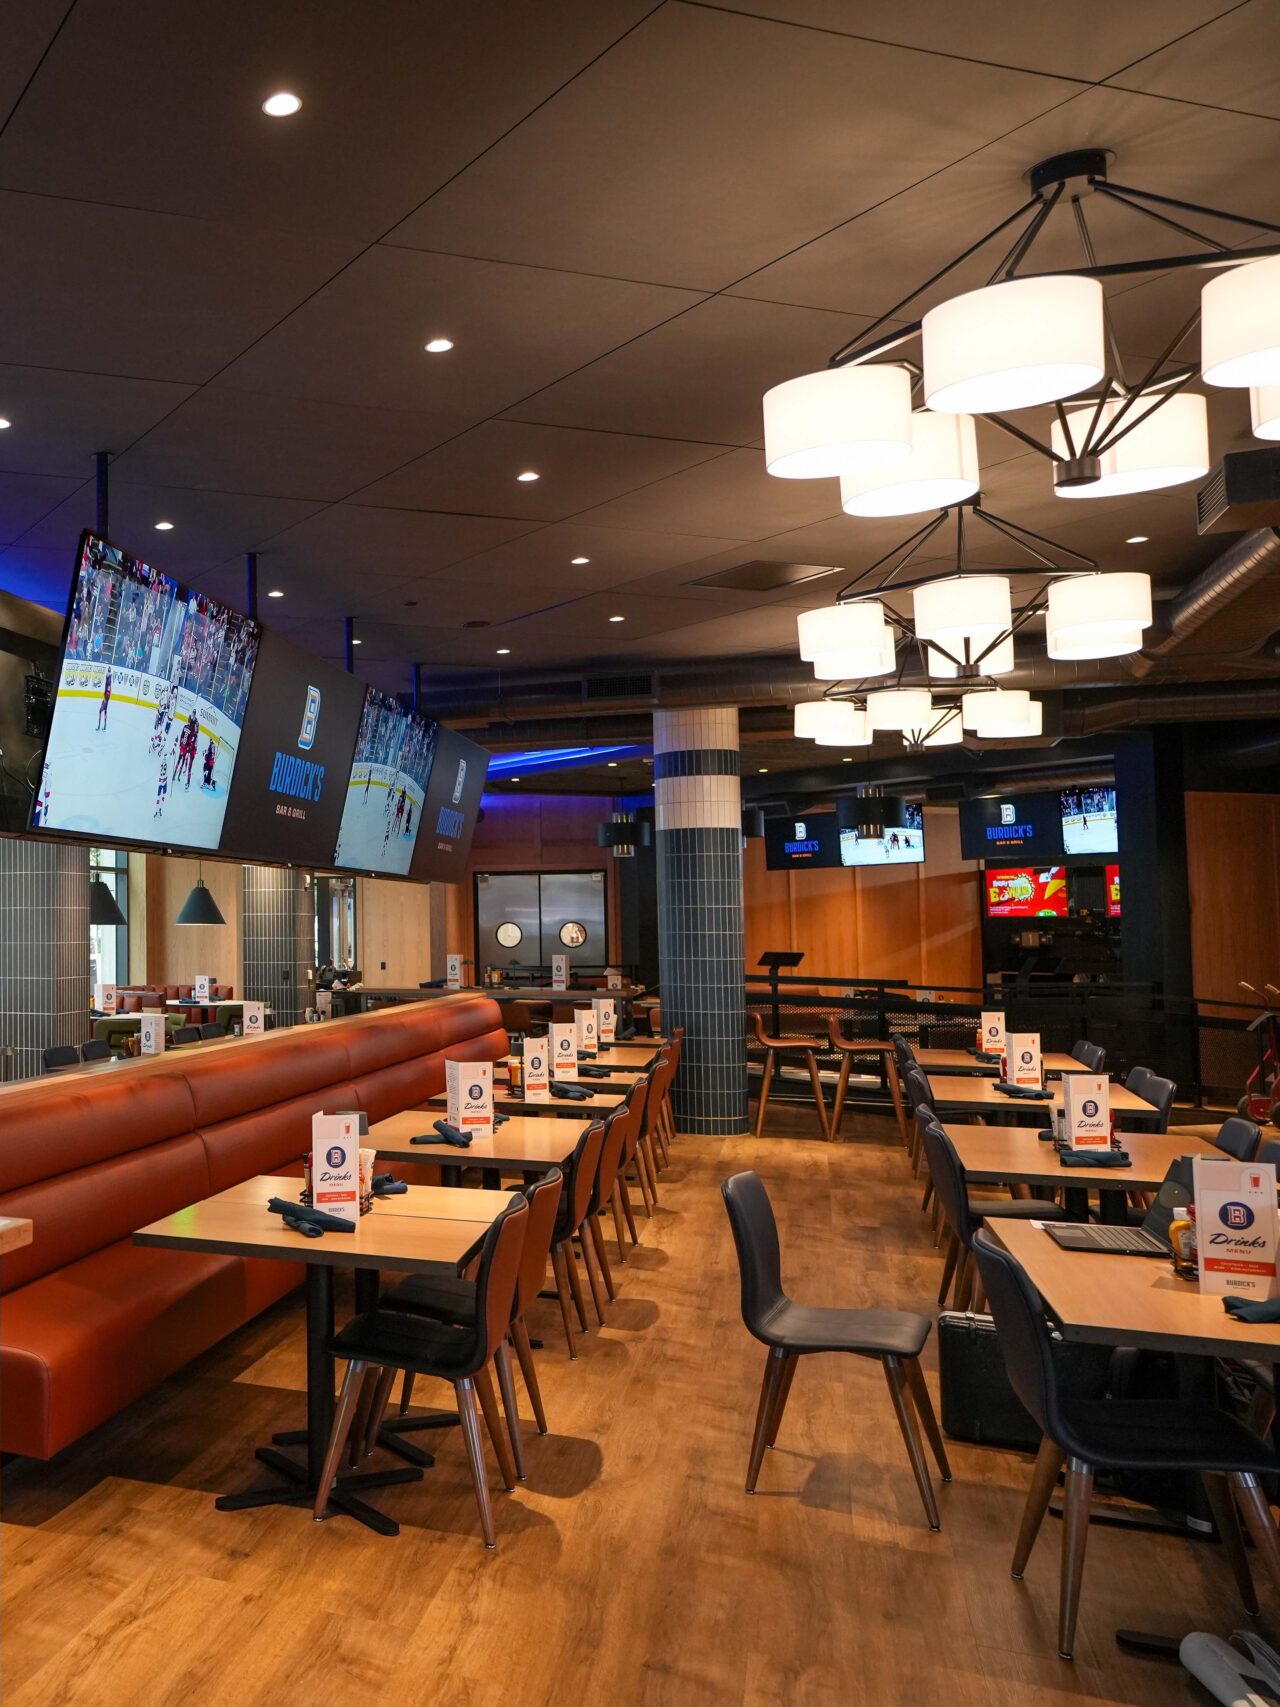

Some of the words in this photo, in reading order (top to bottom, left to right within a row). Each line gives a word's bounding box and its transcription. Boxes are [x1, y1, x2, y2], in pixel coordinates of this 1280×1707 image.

[269, 751, 325, 802] BURDICK'S
[275, 804, 288, 816] BAR
[291, 808, 306, 820] GRILL
[986, 825, 1033, 839] BURDICK'S
[785, 841, 819, 853] BURDICK'S
[464, 1102, 487, 1110] Drinks
[1077, 1120, 1104, 1128] Drinks
[320, 1171, 352, 1182] Drinks
[1209, 1233, 1267, 1248] Drinks
[1226, 1280, 1256, 1288] BURDICK'S
